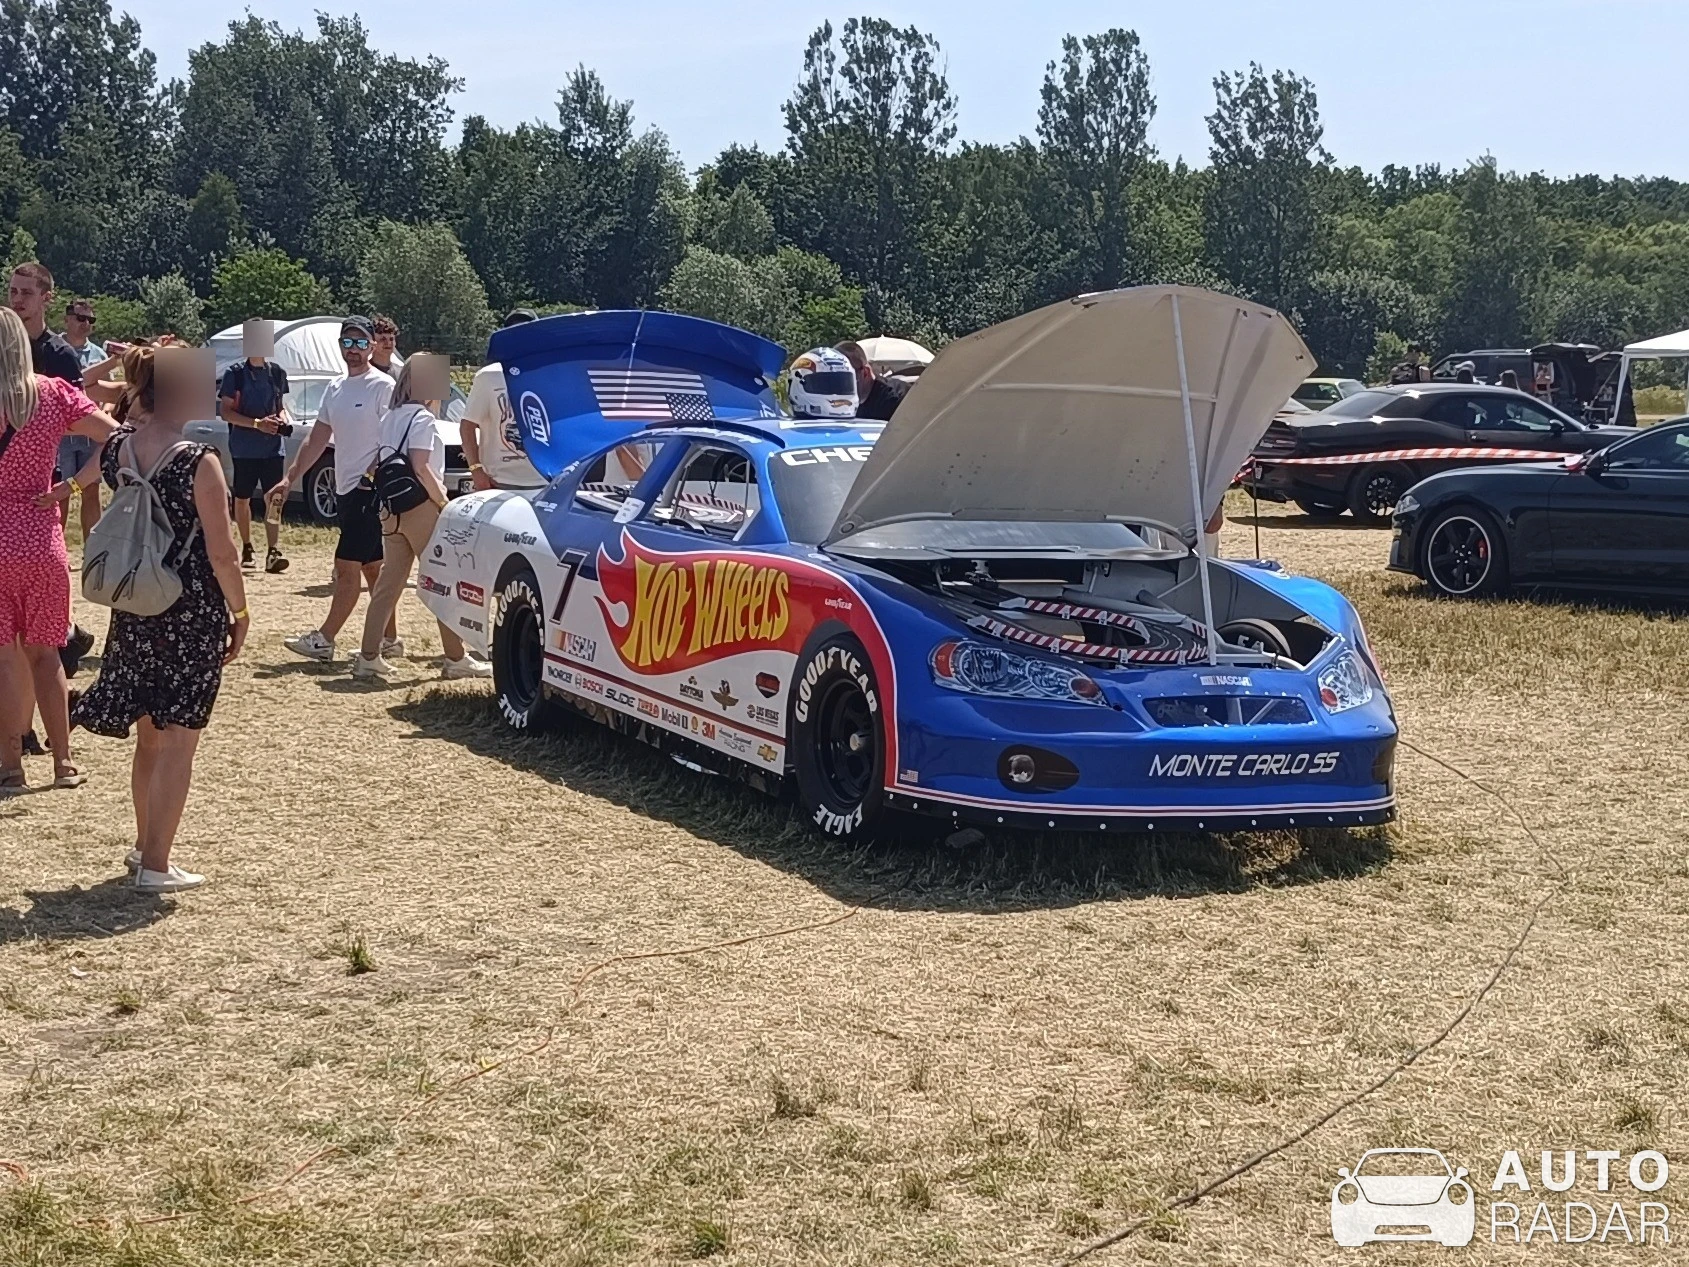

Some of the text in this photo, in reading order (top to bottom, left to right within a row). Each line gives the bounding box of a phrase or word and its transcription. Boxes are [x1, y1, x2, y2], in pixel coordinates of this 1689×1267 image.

[582, 678, 604, 696] BOSCH
[795, 646, 878, 723] GOODYEAR
[1215, 675, 1252, 687] NASCAR
[498, 693, 529, 729] EAGLE
[661, 707, 681, 728] Mobil
[701, 720, 716, 741] 3M
[1148, 751, 1341, 777] MONTE CARLO SS
[813, 801, 864, 837] EAGLE
